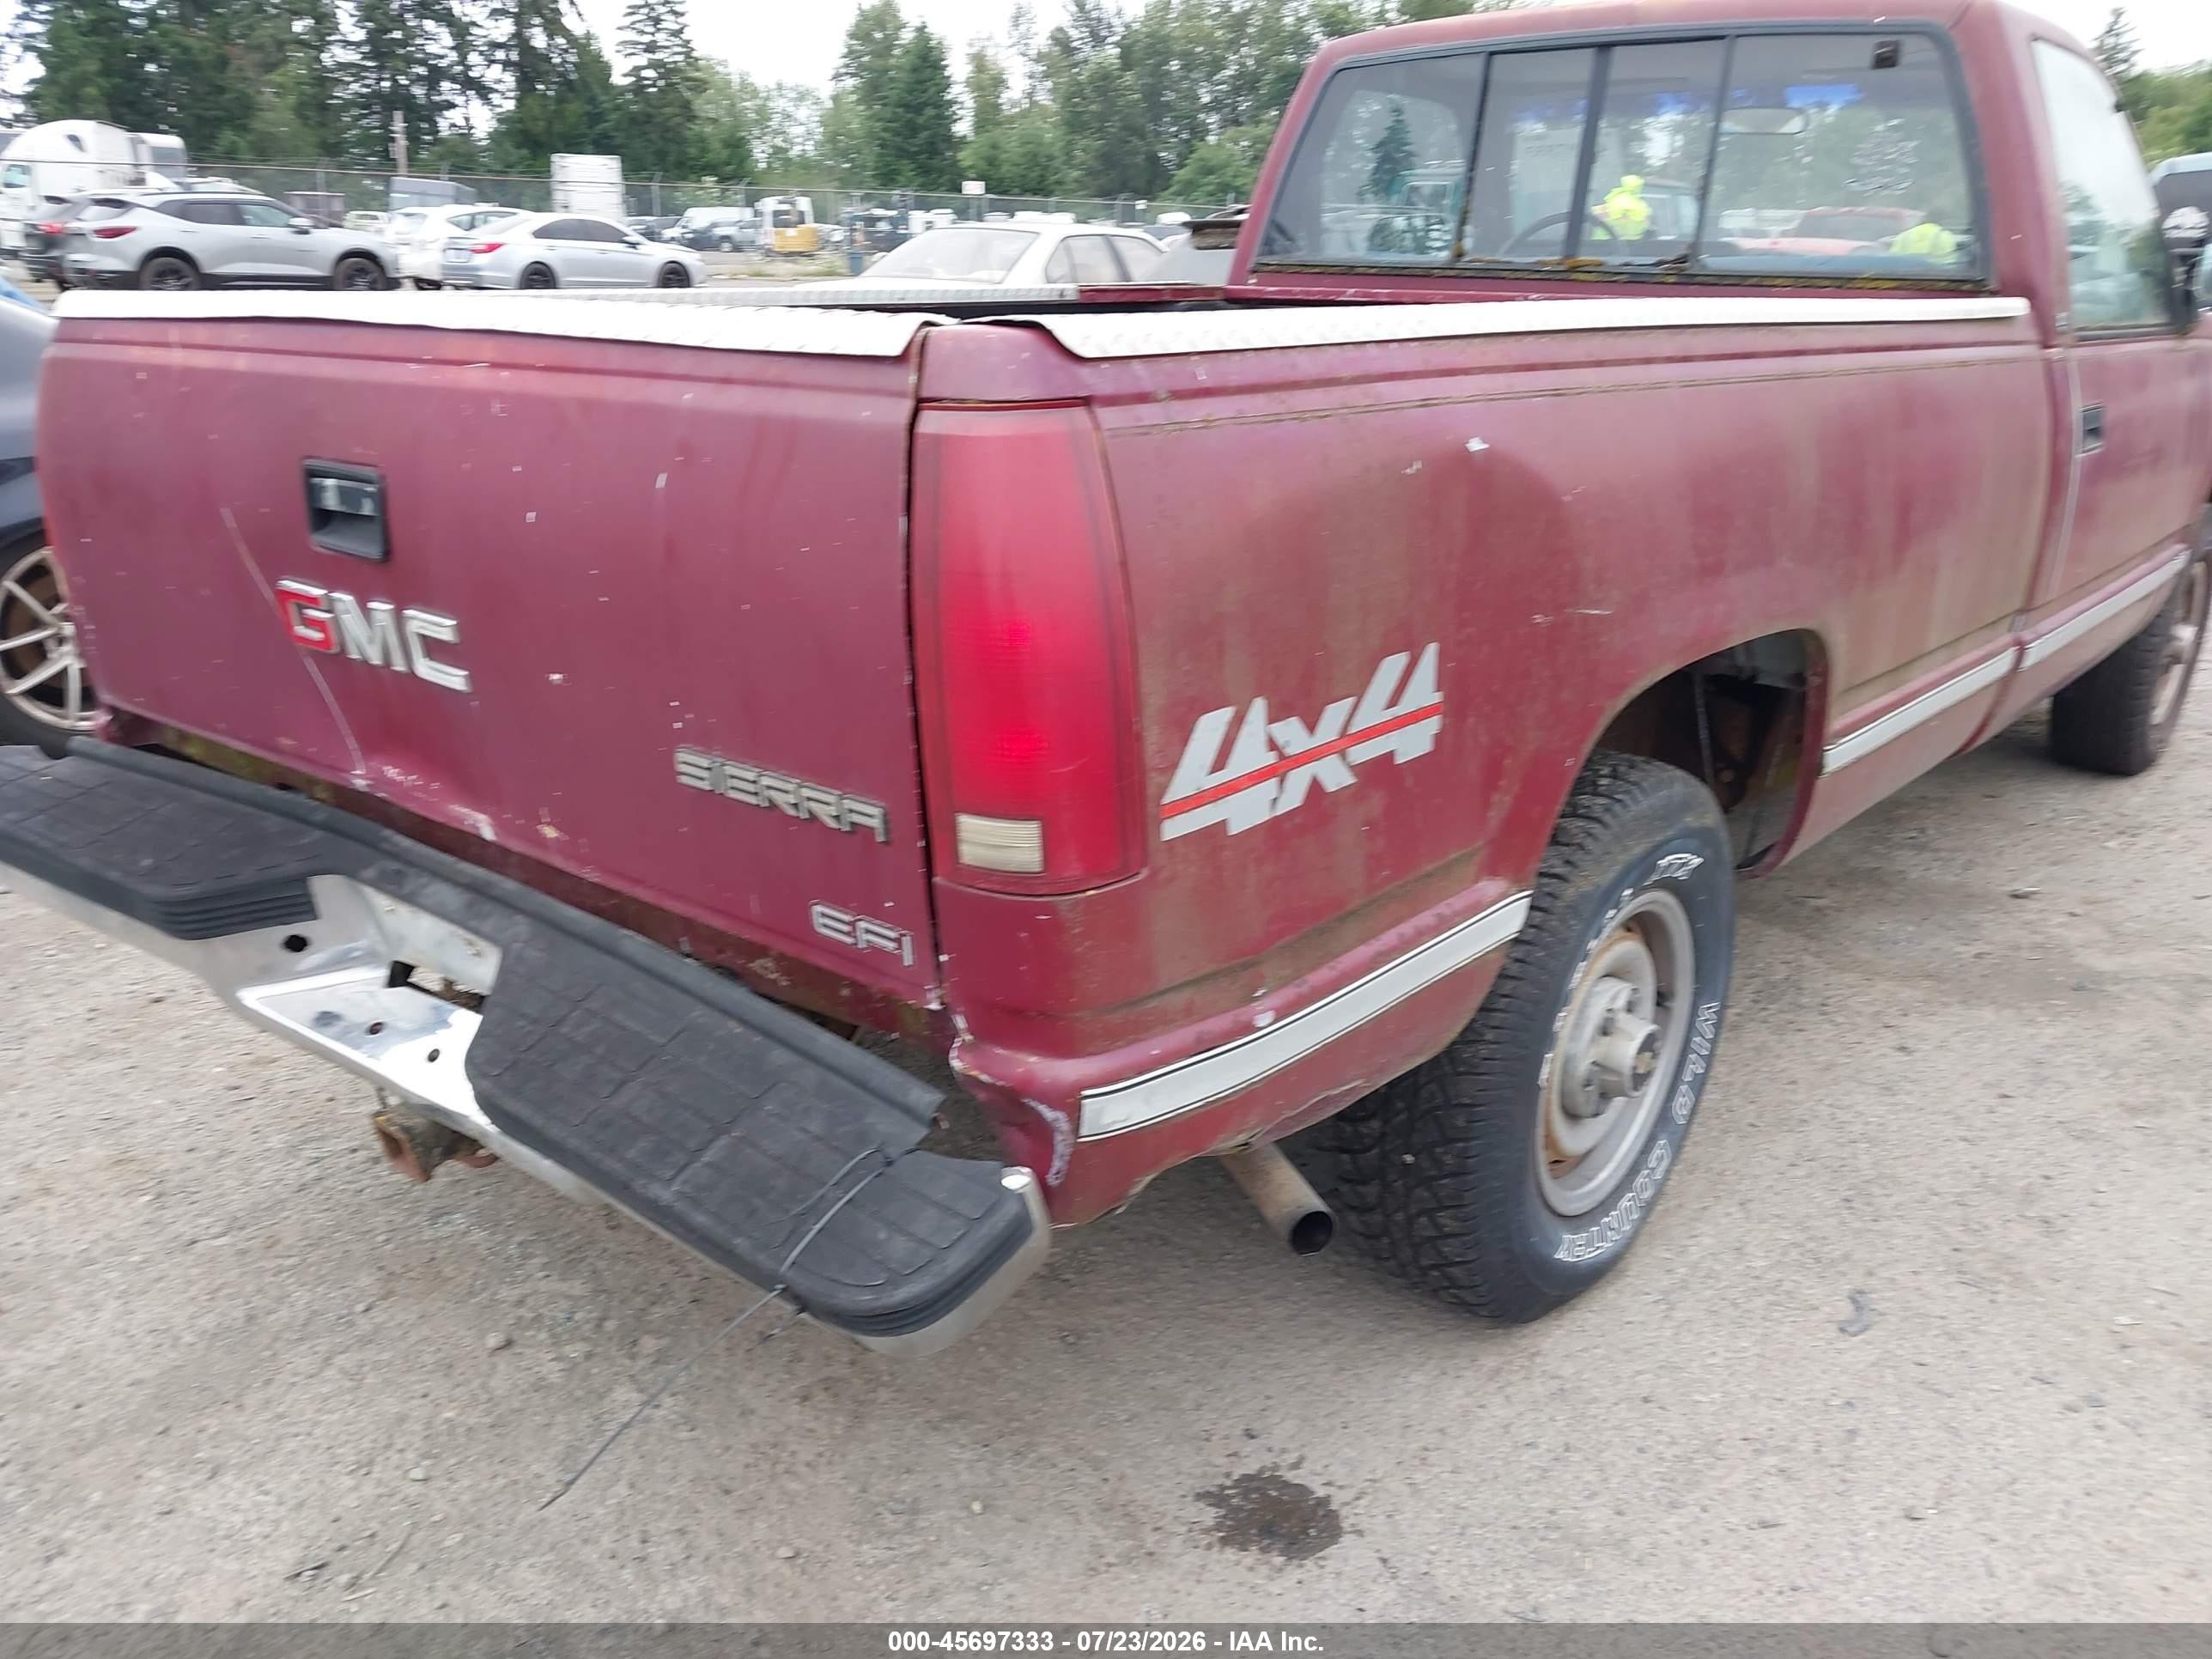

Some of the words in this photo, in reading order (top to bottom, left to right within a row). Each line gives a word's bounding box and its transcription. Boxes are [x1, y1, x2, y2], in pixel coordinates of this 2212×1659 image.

[275, 577, 471, 692] GMC
[673, 745, 888, 843] SIERRA
[810, 900, 915, 968] EFI
[1671, 1001, 1721, 1126] WILD
[1553, 1139, 1673, 1261] COUNTRY
